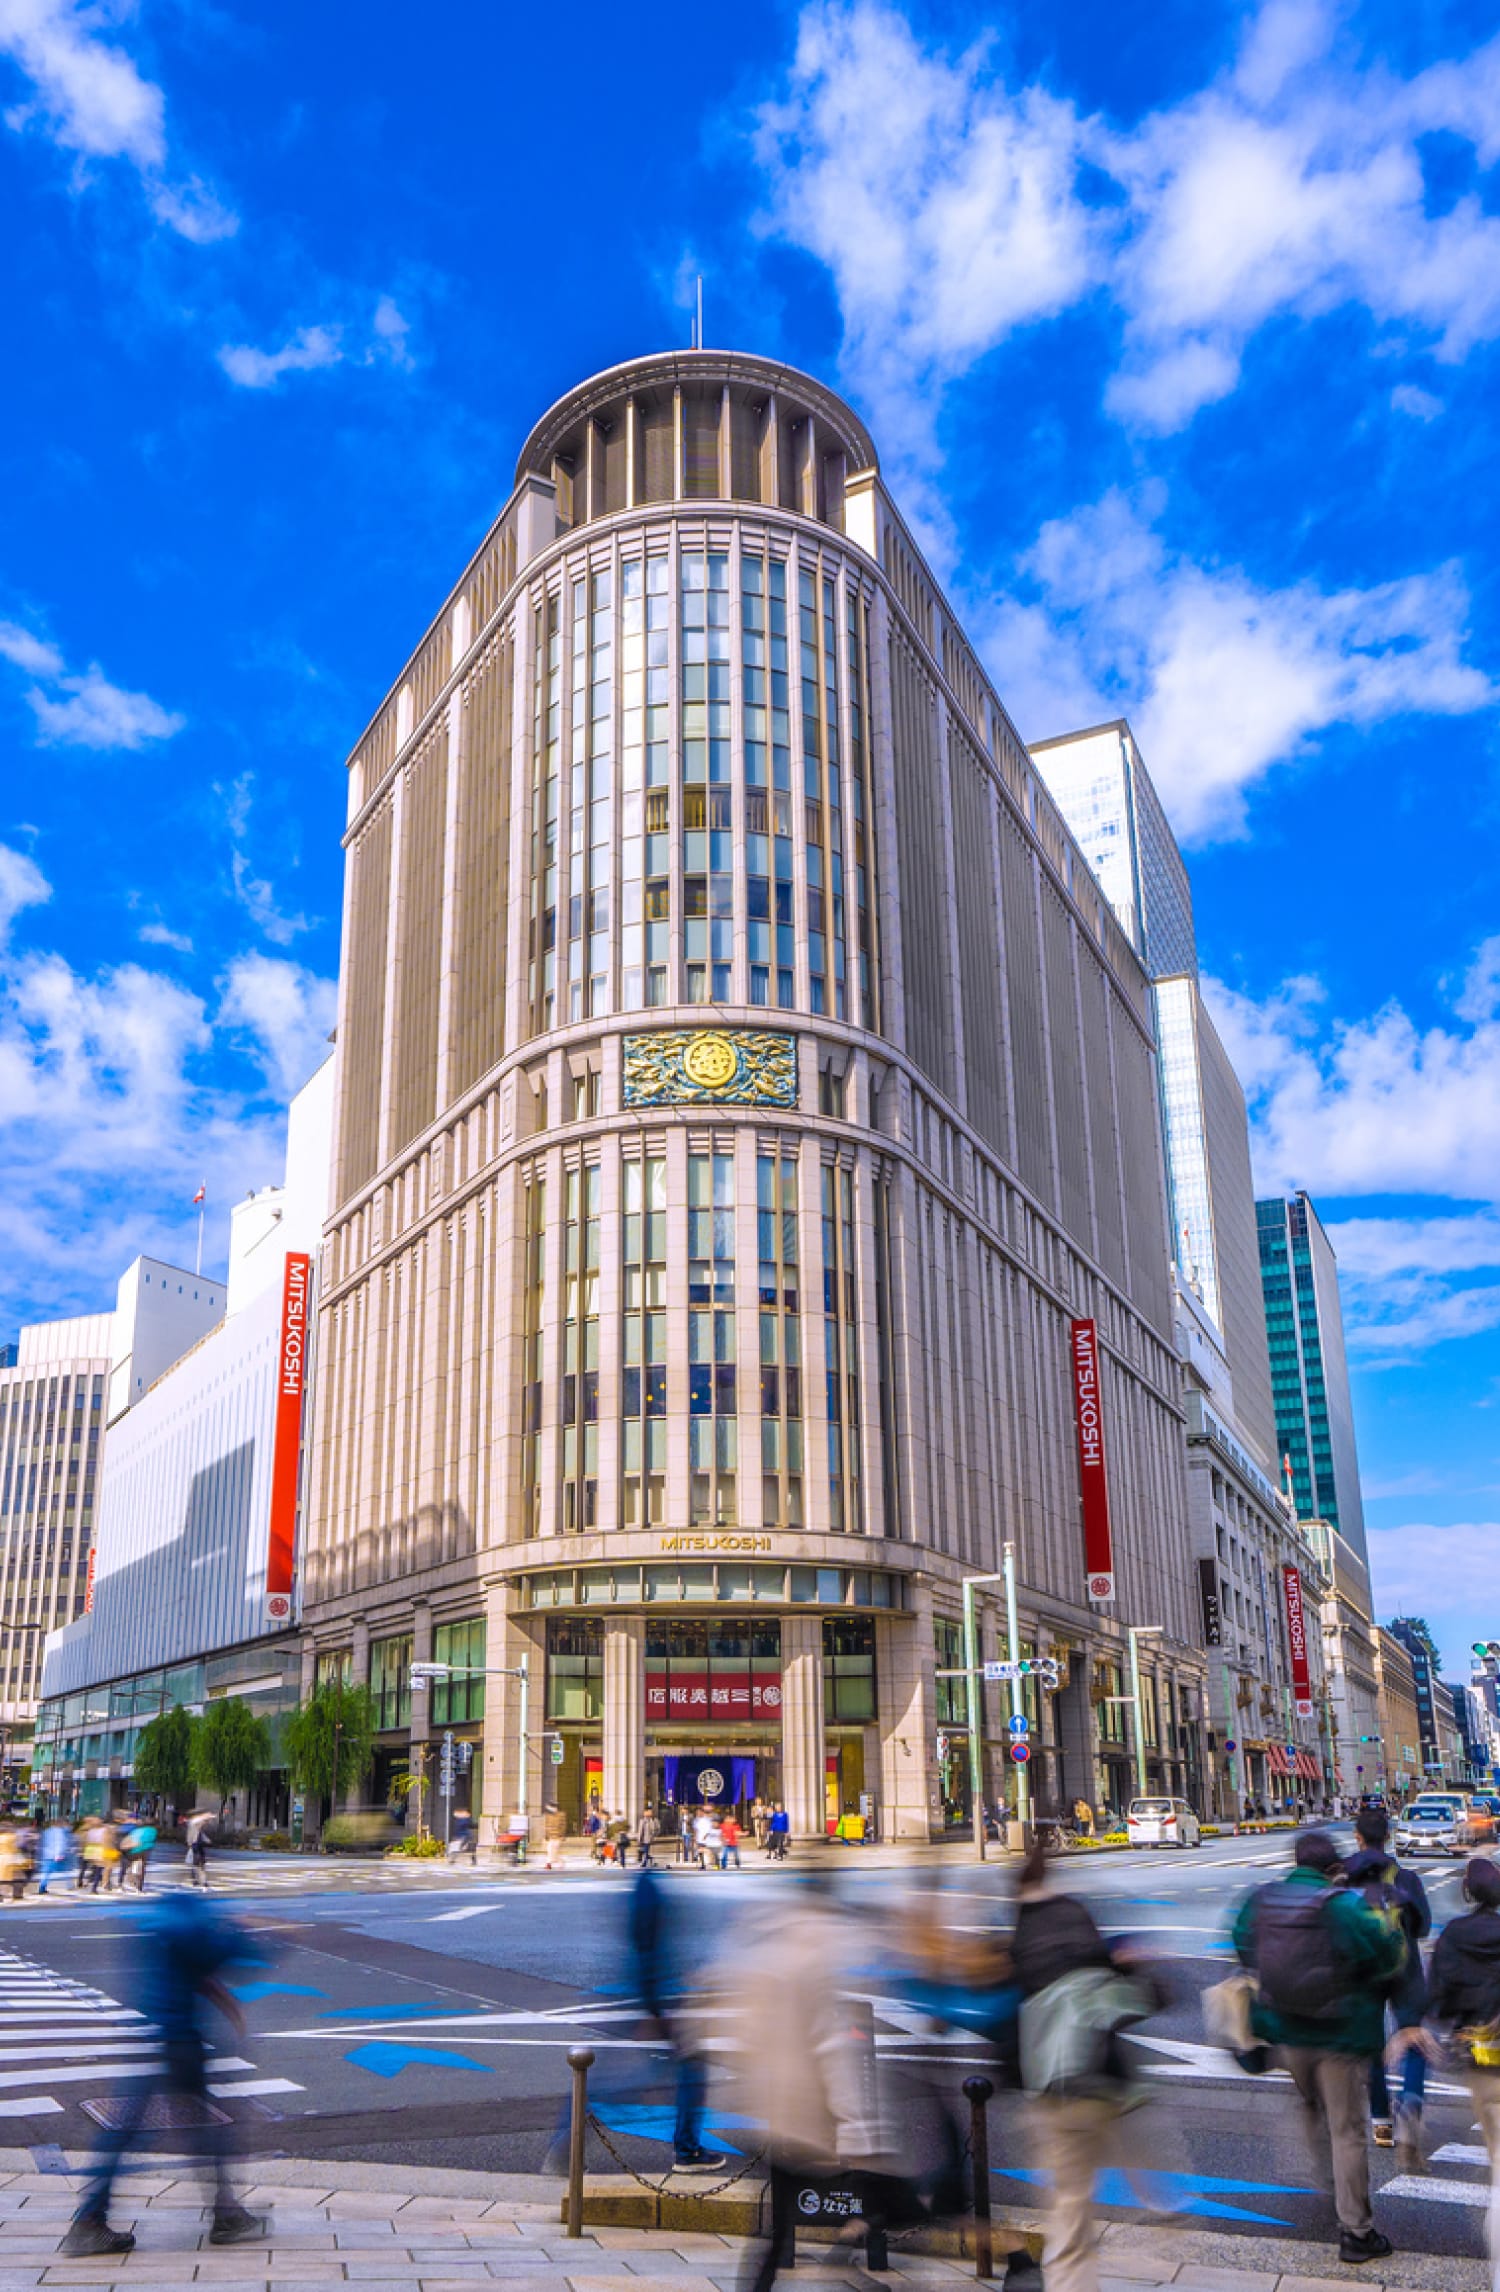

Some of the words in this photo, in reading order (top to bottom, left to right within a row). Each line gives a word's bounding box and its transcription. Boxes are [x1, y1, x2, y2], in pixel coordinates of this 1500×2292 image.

[283, 1262, 305, 1395] MITSUKOSHI
[1075, 1329, 1100, 1466] MITSUKOSHI
[661, 1536, 772, 1551] MITSUKOSHI
[1286, 1573, 1305, 1660] MITSUKOSHI
